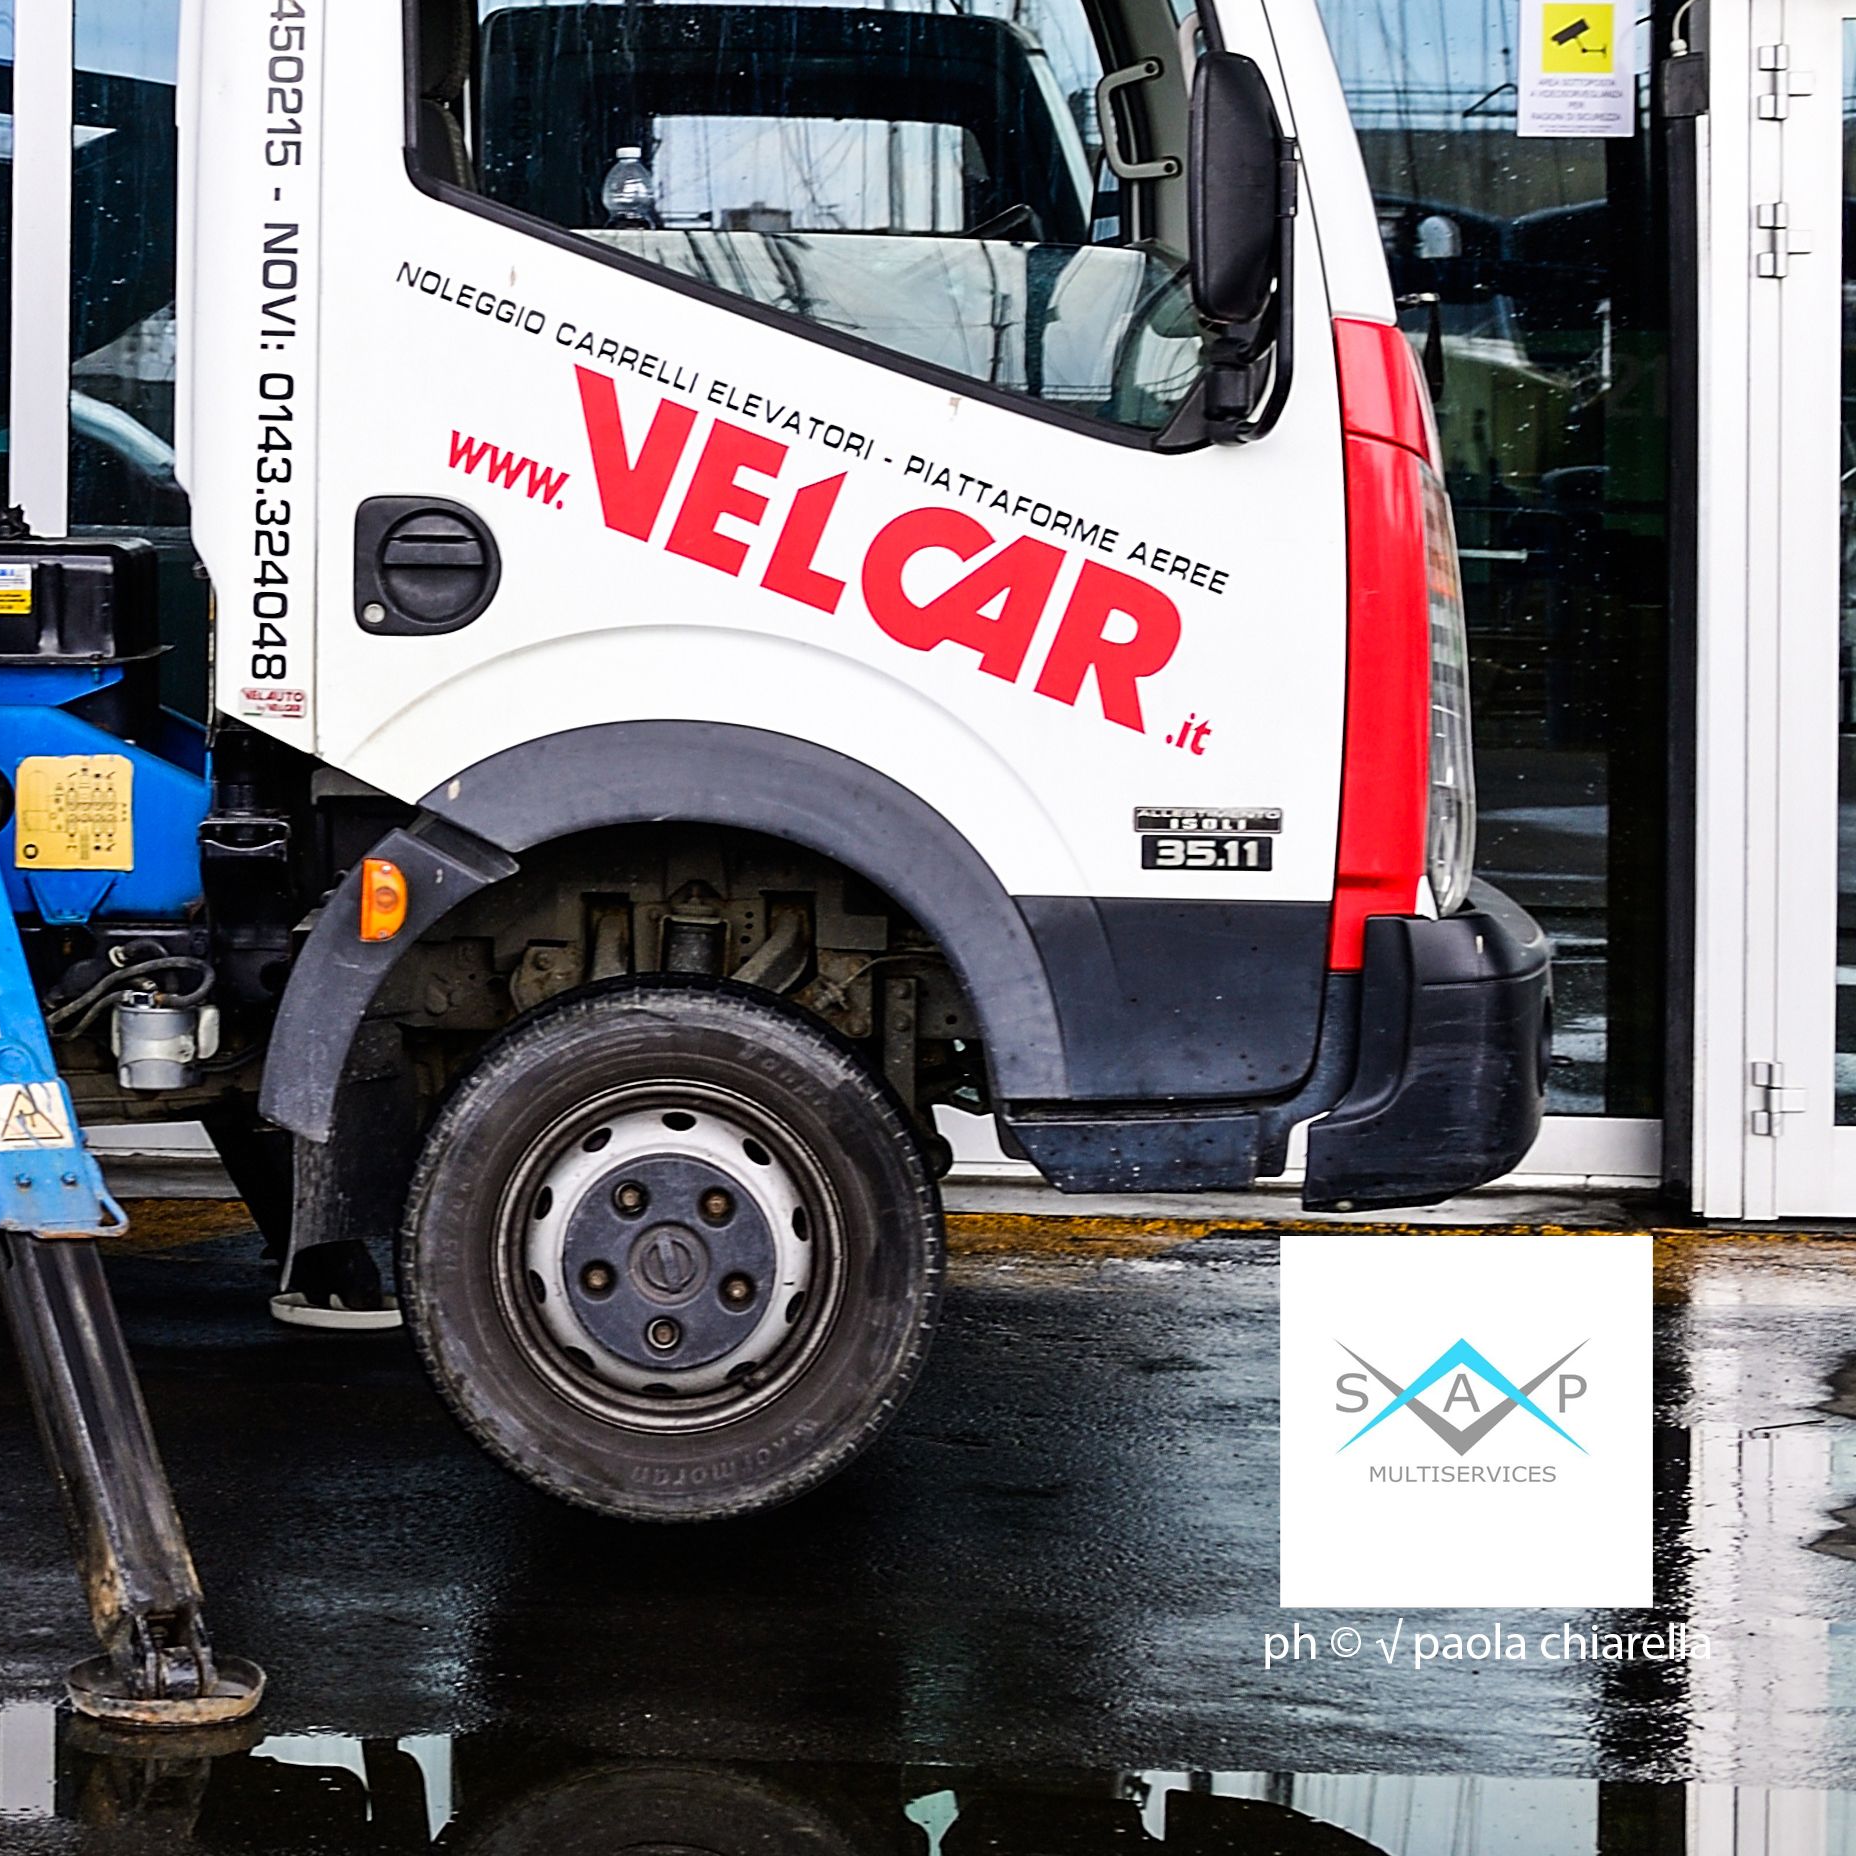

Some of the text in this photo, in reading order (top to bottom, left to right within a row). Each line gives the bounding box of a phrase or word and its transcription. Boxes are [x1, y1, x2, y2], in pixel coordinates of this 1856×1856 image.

[260, 223, 299, 350] NOVI:
[396, 261, 546, 335] NOLEGGIO
[556, 322, 699, 394] CARRELLI
[707, 380, 874, 460] ELEVATORI
[903, 454, 1120, 553] PIATTAFORME
[1126, 541, 1230, 595] AEREE
[251, 372, 294, 680] 0143.324048
[1155, 839, 1259, 867] 35.11
[1169, 818, 1248, 830] ISOLI
